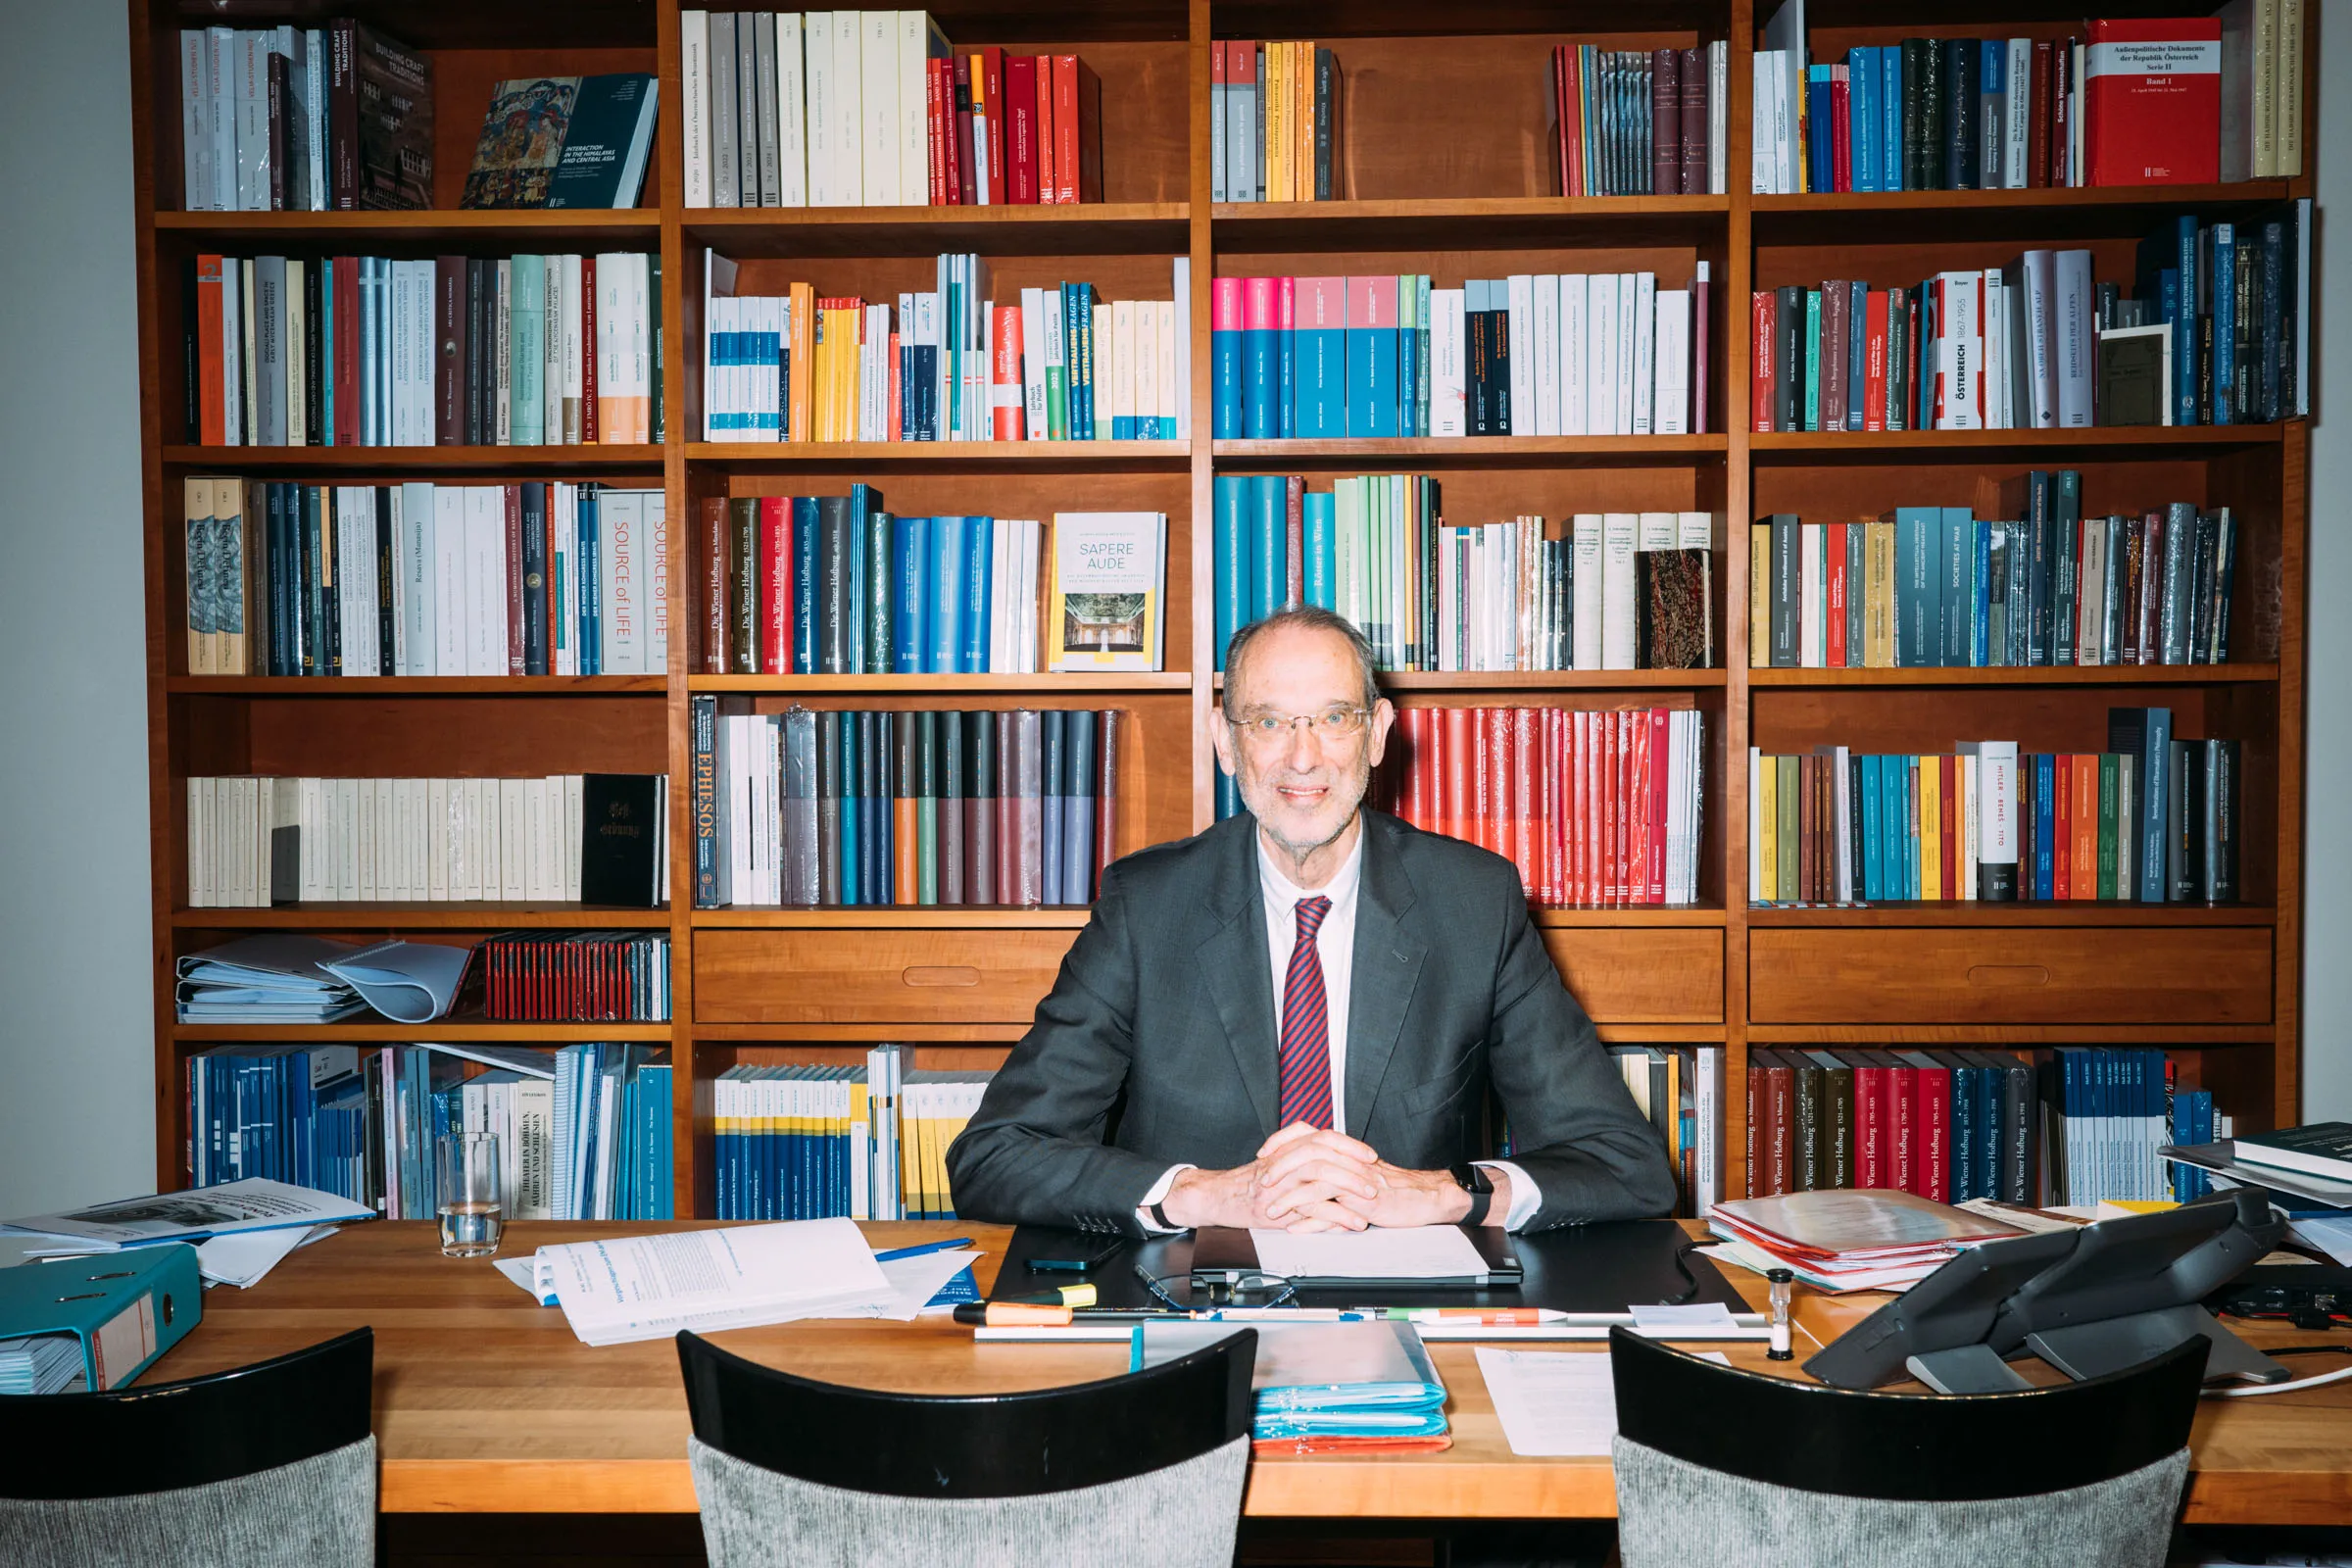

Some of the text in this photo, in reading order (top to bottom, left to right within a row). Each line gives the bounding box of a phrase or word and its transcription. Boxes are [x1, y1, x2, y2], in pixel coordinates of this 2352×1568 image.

[1957, 299, 1965, 338] 1867–1955
[1069, 296, 1078, 387] VERTRAUENSFRAGEN
[1080, 544, 1133, 555] SAPERE
[1954, 543, 1960, 552] AT
[711, 557, 720, 585] Hofburg
[742, 556, 750, 585] Hofburg
[830, 555, 839, 584] Hofburg
[1088, 558, 1125, 569] AUDE
[615, 522, 630, 635] SOURCE of LIFE
[711, 587, 720, 614] Wiener
[742, 587, 750, 613] Wiener
[830, 587, 839, 612] Wiener
[711, 616, 720, 629] Die
[742, 615, 750, 628] Die
[830, 614, 839, 627] Die
[698, 753, 713, 837] EPHESOS
[531, 1114, 540, 1155] SCHLESIEN
[1931, 1128, 1940, 1159] Hofburg
[1961, 1129, 1969, 1159] Hofburg
[522, 1112, 531, 1192] THEATER IN BÖHMEN,
[531, 1174, 540, 1207] MÄHREN
[1961, 1189, 1970, 1202] Die
